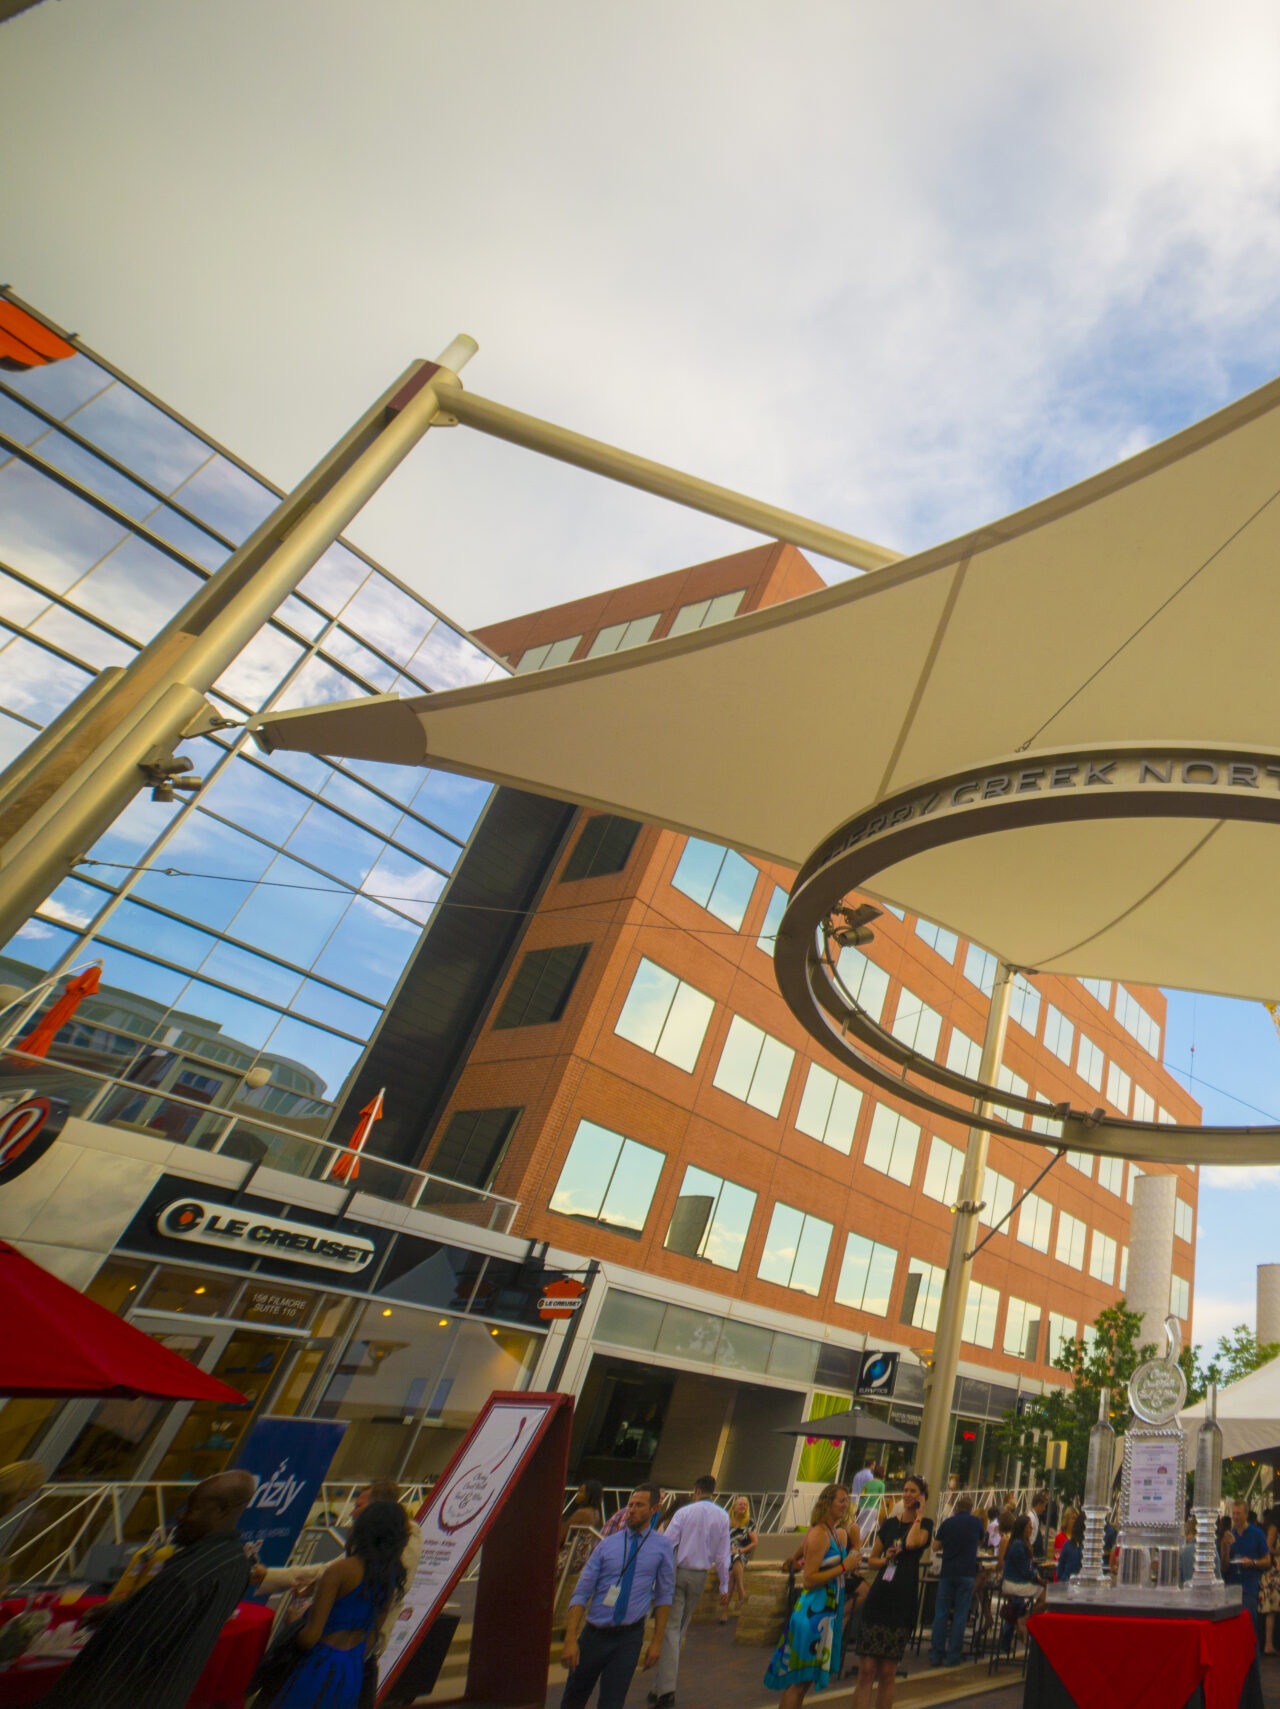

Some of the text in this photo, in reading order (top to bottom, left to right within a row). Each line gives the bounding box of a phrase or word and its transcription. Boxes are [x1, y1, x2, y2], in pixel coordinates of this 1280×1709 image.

[950, 760, 1117, 807] CREEK
[203, 1214, 375, 1265] LE CREUSET
[246, 1457, 307, 1516] rizly
